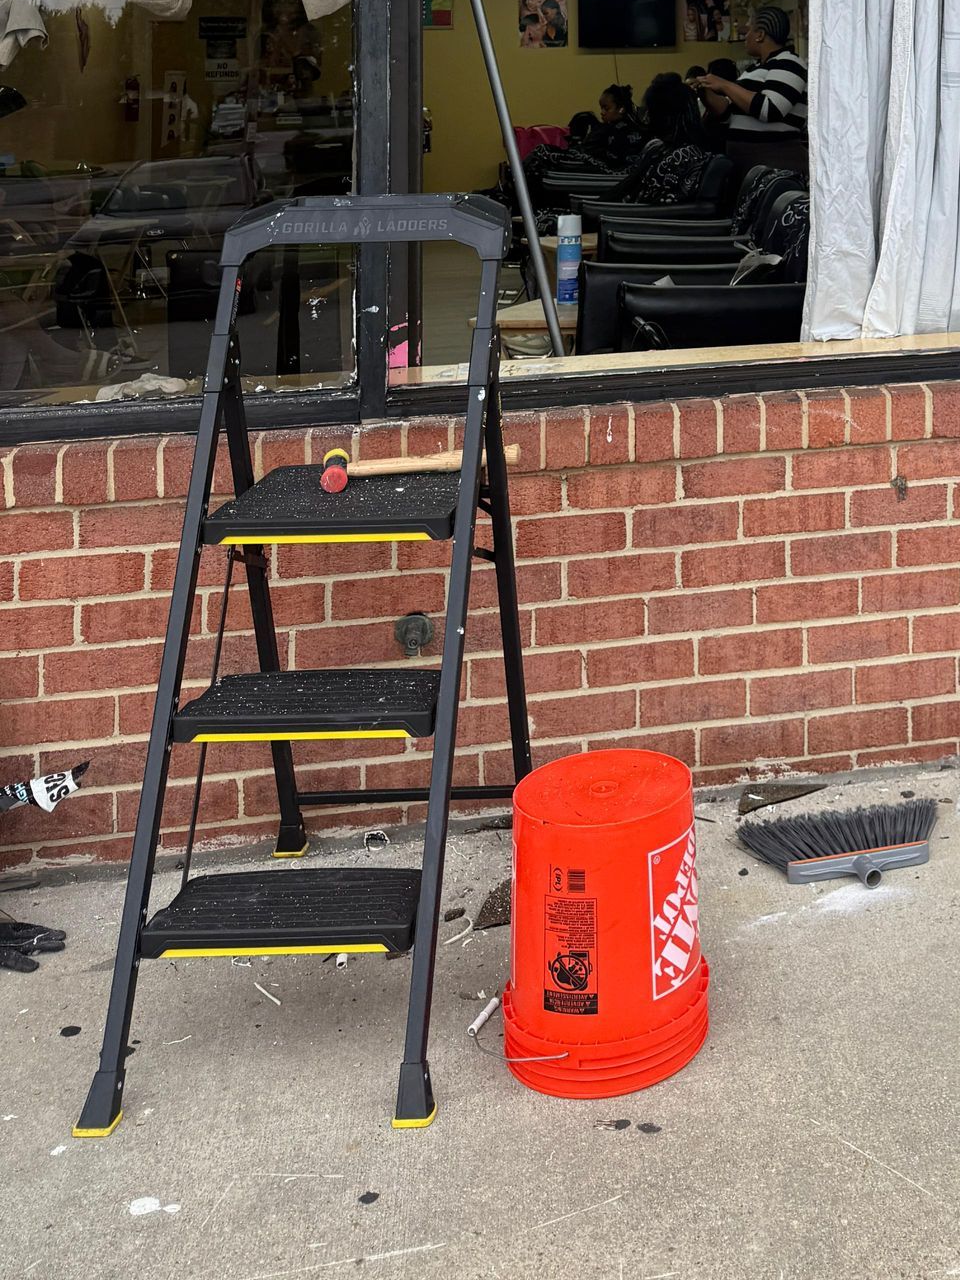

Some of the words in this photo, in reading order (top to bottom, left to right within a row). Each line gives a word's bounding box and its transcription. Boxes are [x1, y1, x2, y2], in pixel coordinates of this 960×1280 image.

[216, 62, 228, 70] NO
[205, 70, 240, 78] REFUNDS
[281, 222, 348, 234] GORILLA
[377, 219, 448, 232] LADDERS
[653, 827, 697, 941] DEPOT
